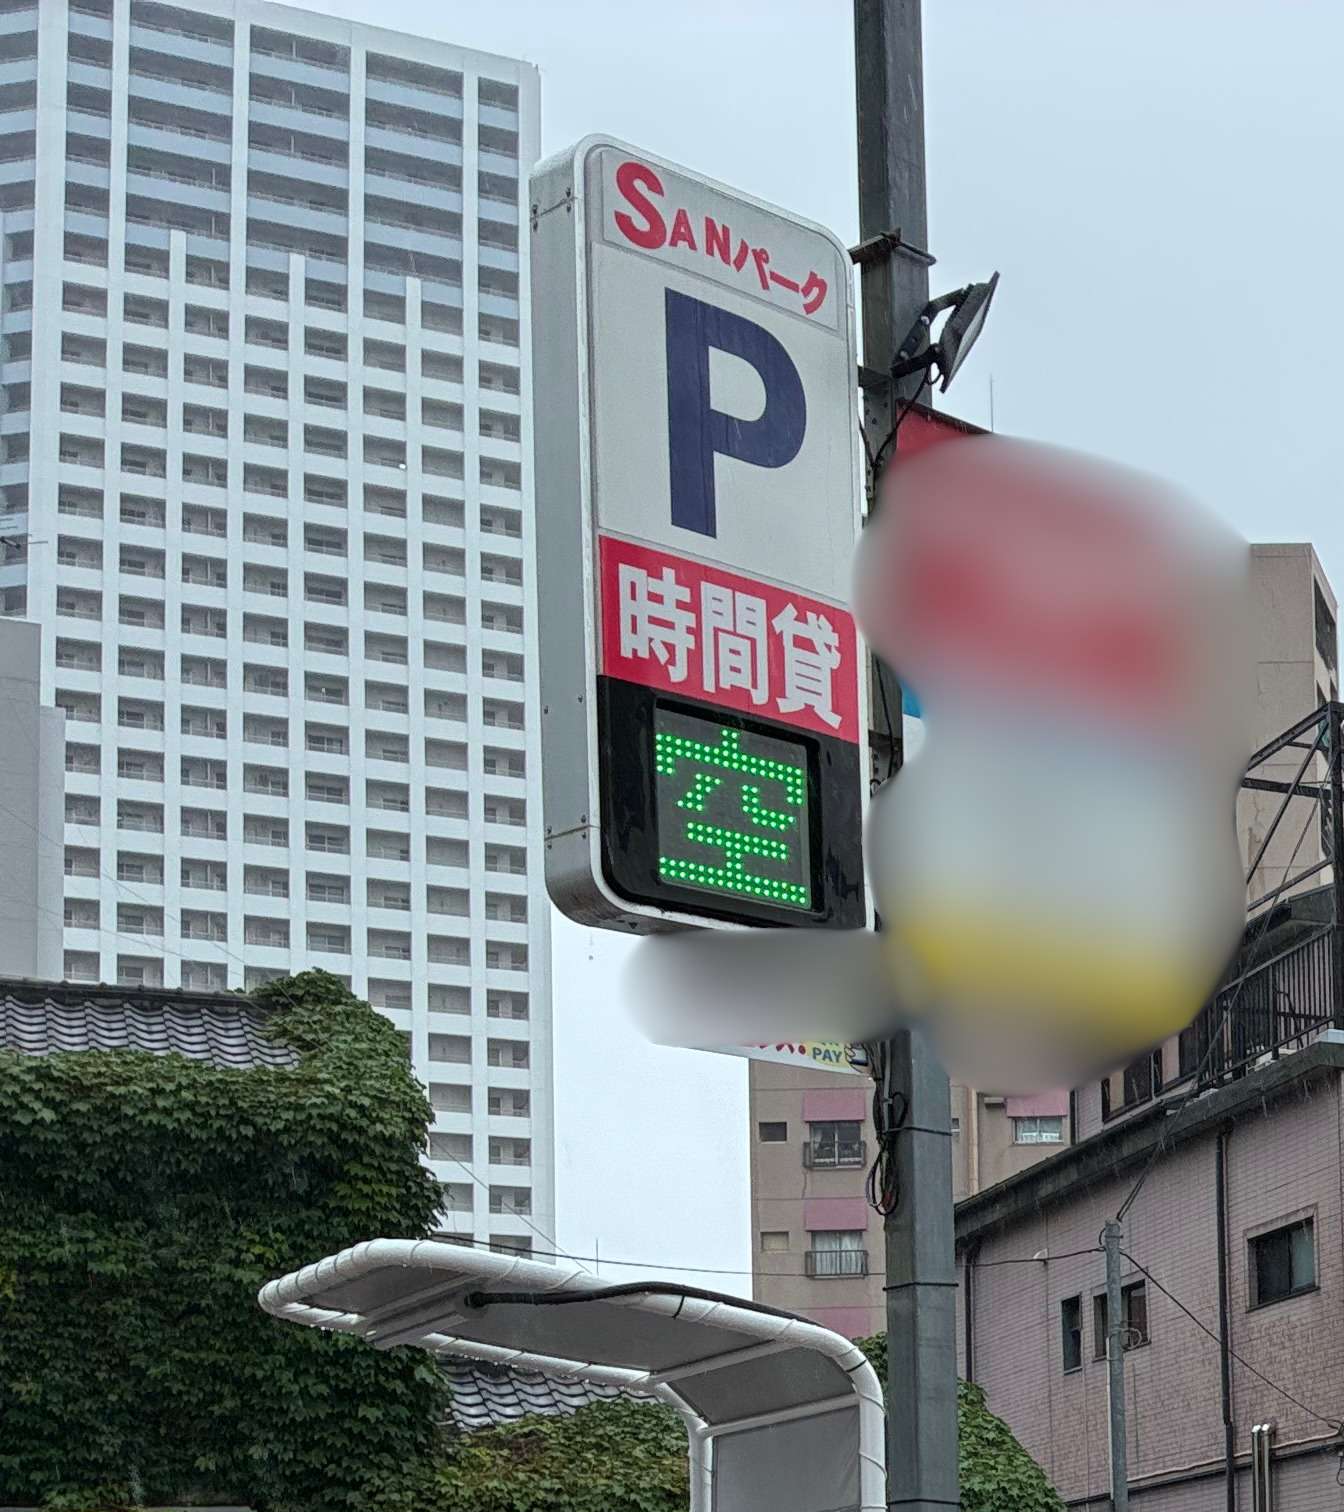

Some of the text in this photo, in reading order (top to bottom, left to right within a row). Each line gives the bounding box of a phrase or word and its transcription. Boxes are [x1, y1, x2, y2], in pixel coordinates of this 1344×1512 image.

[664, 287, 807, 539] P
[617, 565, 844, 729] 時間貸
[655, 728, 808, 905] 空
[811, 1047, 842, 1063] PAY
